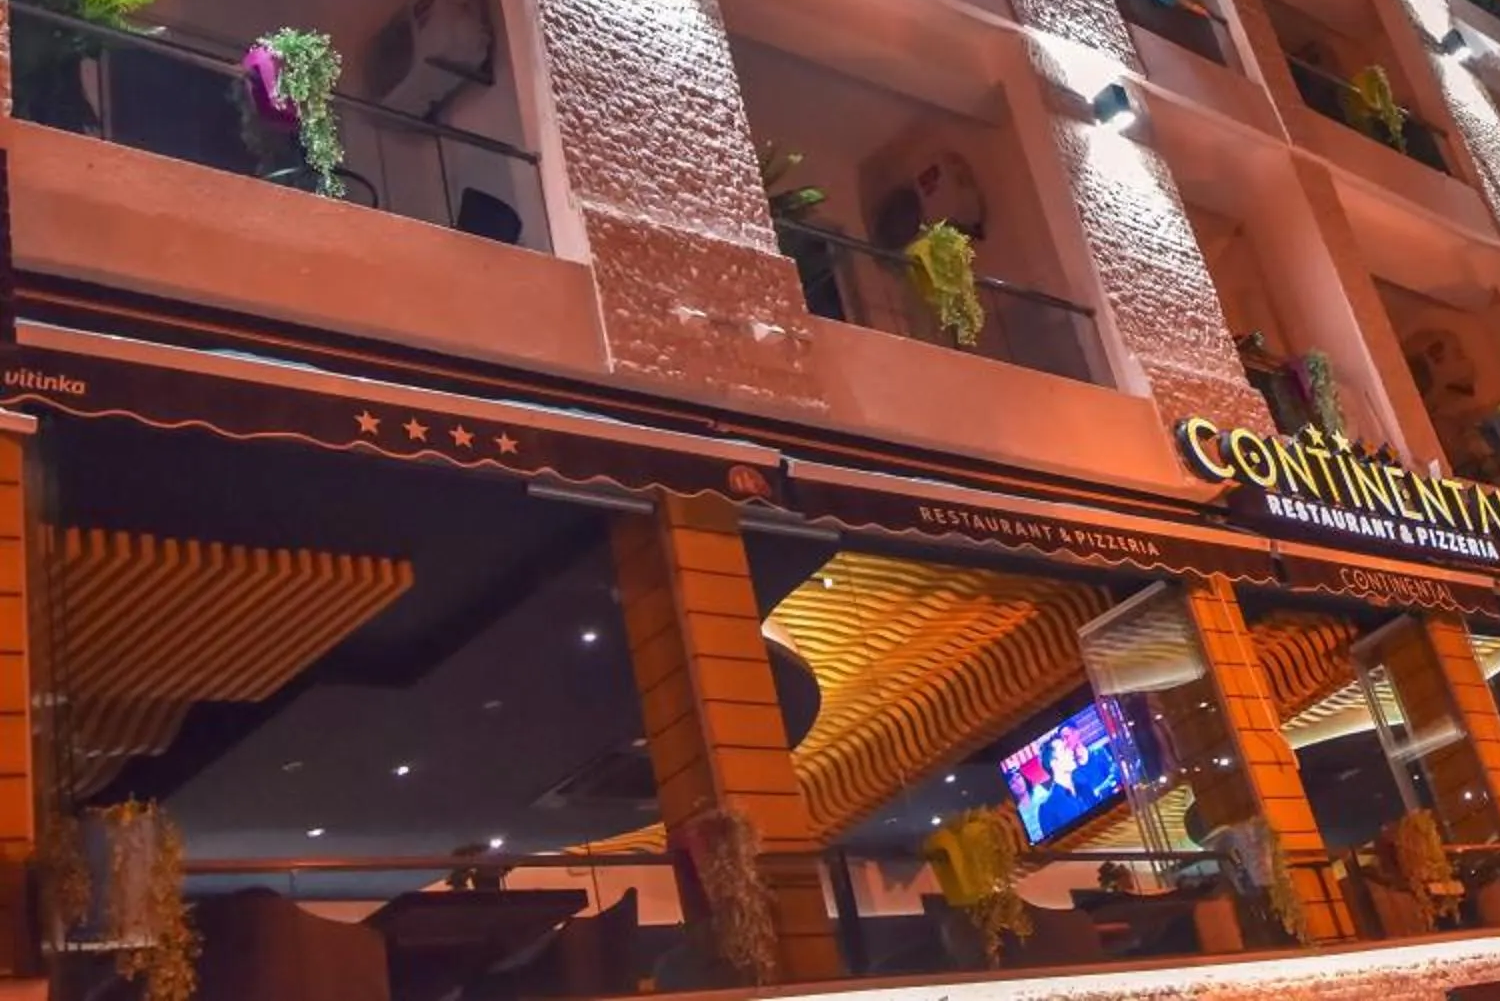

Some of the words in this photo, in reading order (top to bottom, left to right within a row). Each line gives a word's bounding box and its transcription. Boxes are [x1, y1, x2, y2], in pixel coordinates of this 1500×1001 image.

[919, 506, 1051, 541] RESTAURANT
[1059, 526, 1071, 543] &
[1075, 530, 1160, 557] PIZZERIA
[1265, 494, 1397, 540] RESTAURANT
[1400, 527, 1415, 545] &
[1418, 527, 1499, 561] PIZZERIA
[1340, 567, 1456, 605] CONTINENTAL
